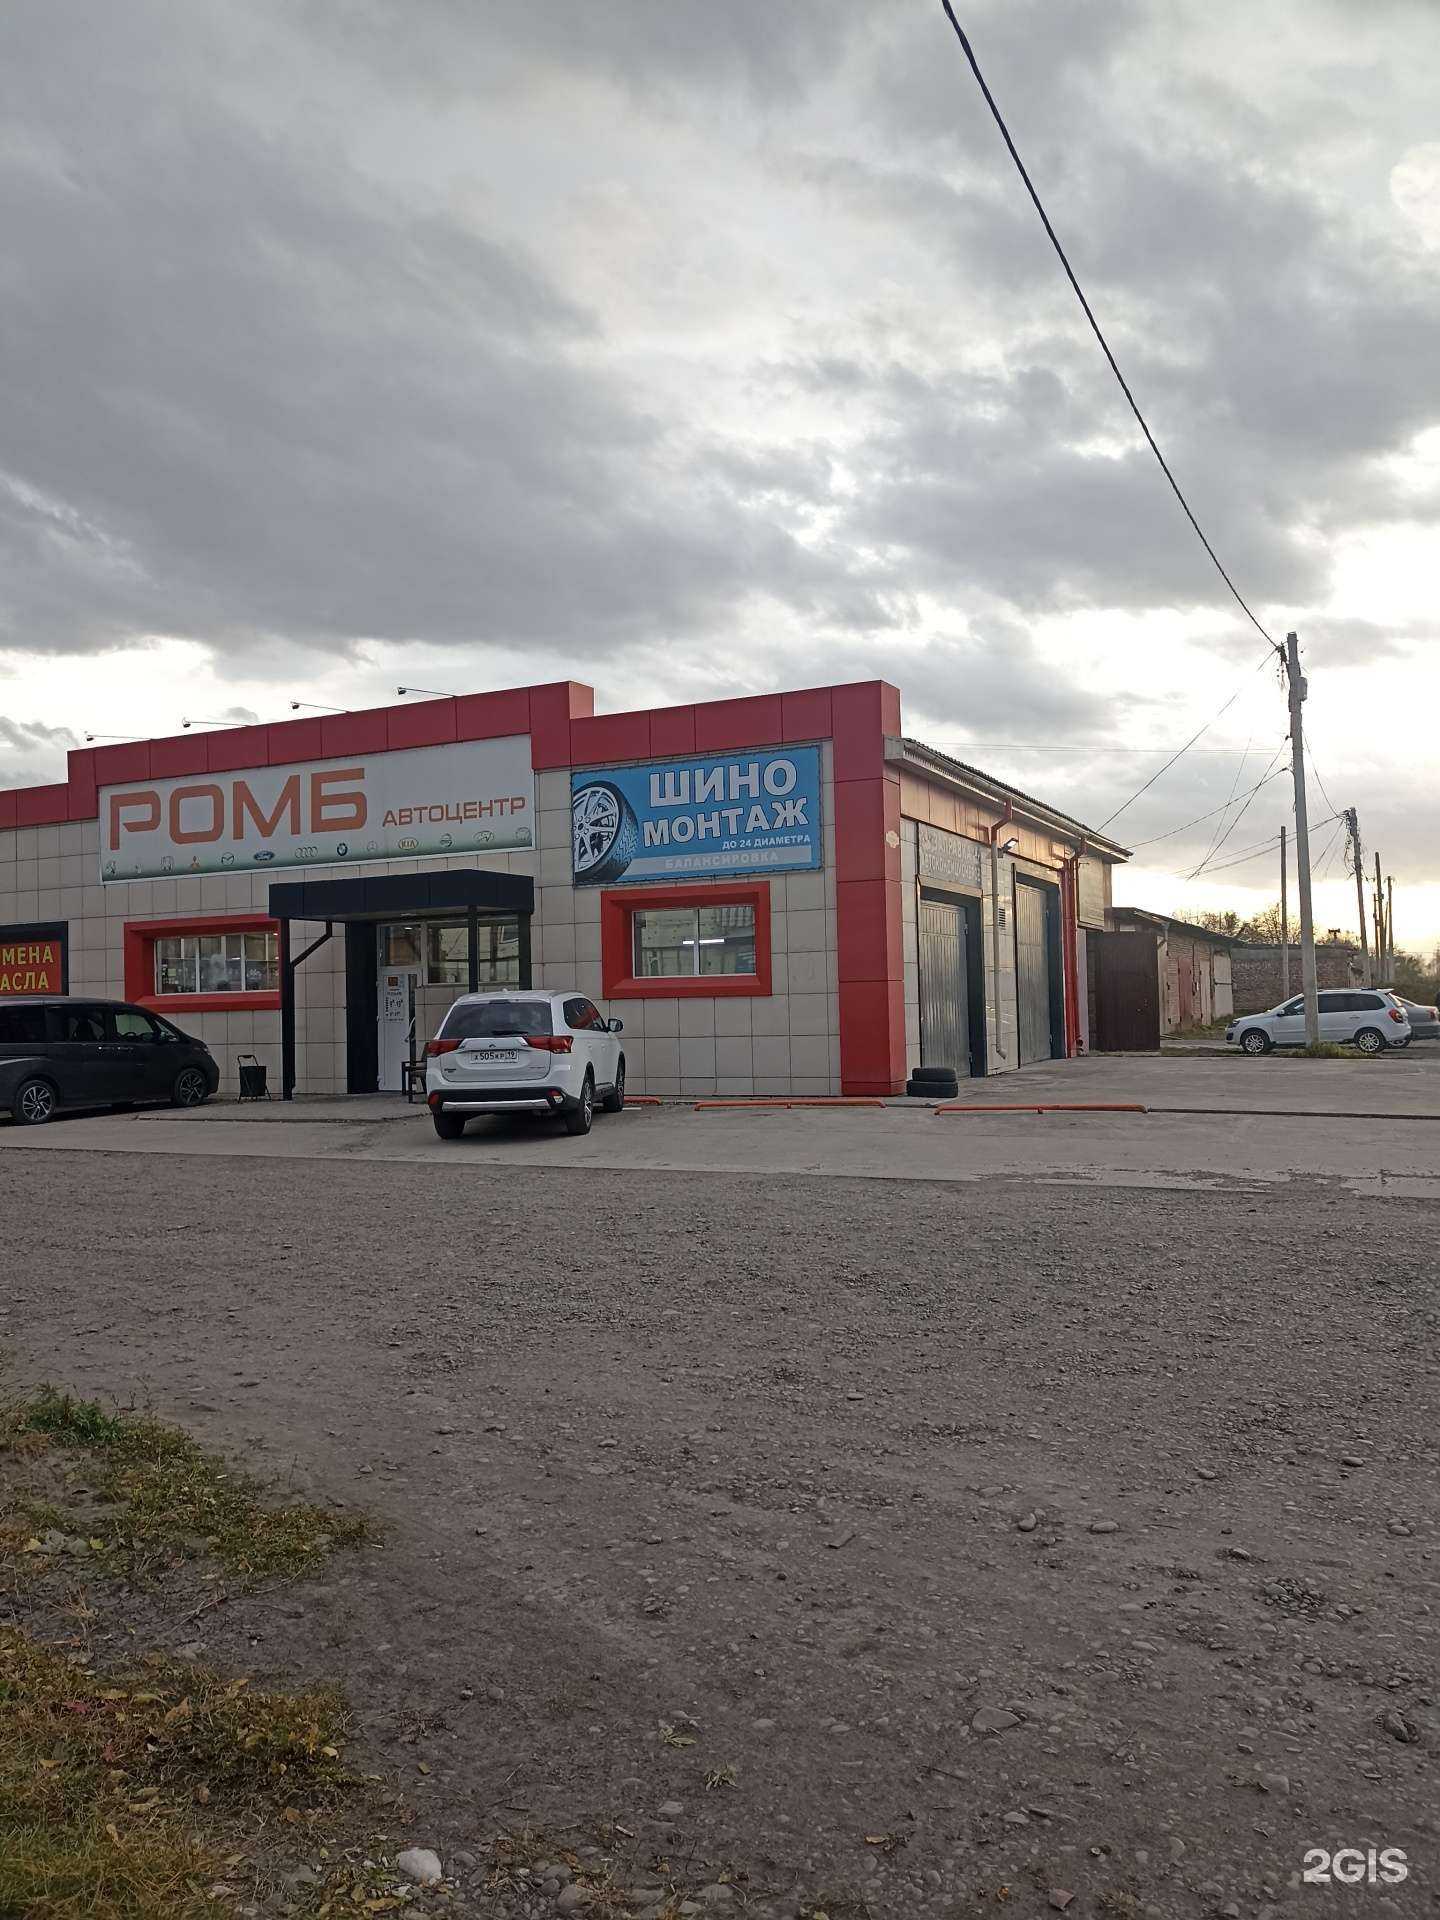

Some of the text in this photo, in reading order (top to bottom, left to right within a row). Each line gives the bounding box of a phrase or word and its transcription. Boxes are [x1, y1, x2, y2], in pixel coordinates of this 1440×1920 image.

[650, 759, 798, 808] ШИНО
[110, 767, 367, 850] РОМБ
[382, 797, 526, 827] АВТОЦЕНТР
[643, 797, 809, 847] МОНТАЖ
[664, 850, 780, 870] БАЛАНСИРОВКА
[722, 834, 811, 850] ДО 24 ДИАМЕТРА
